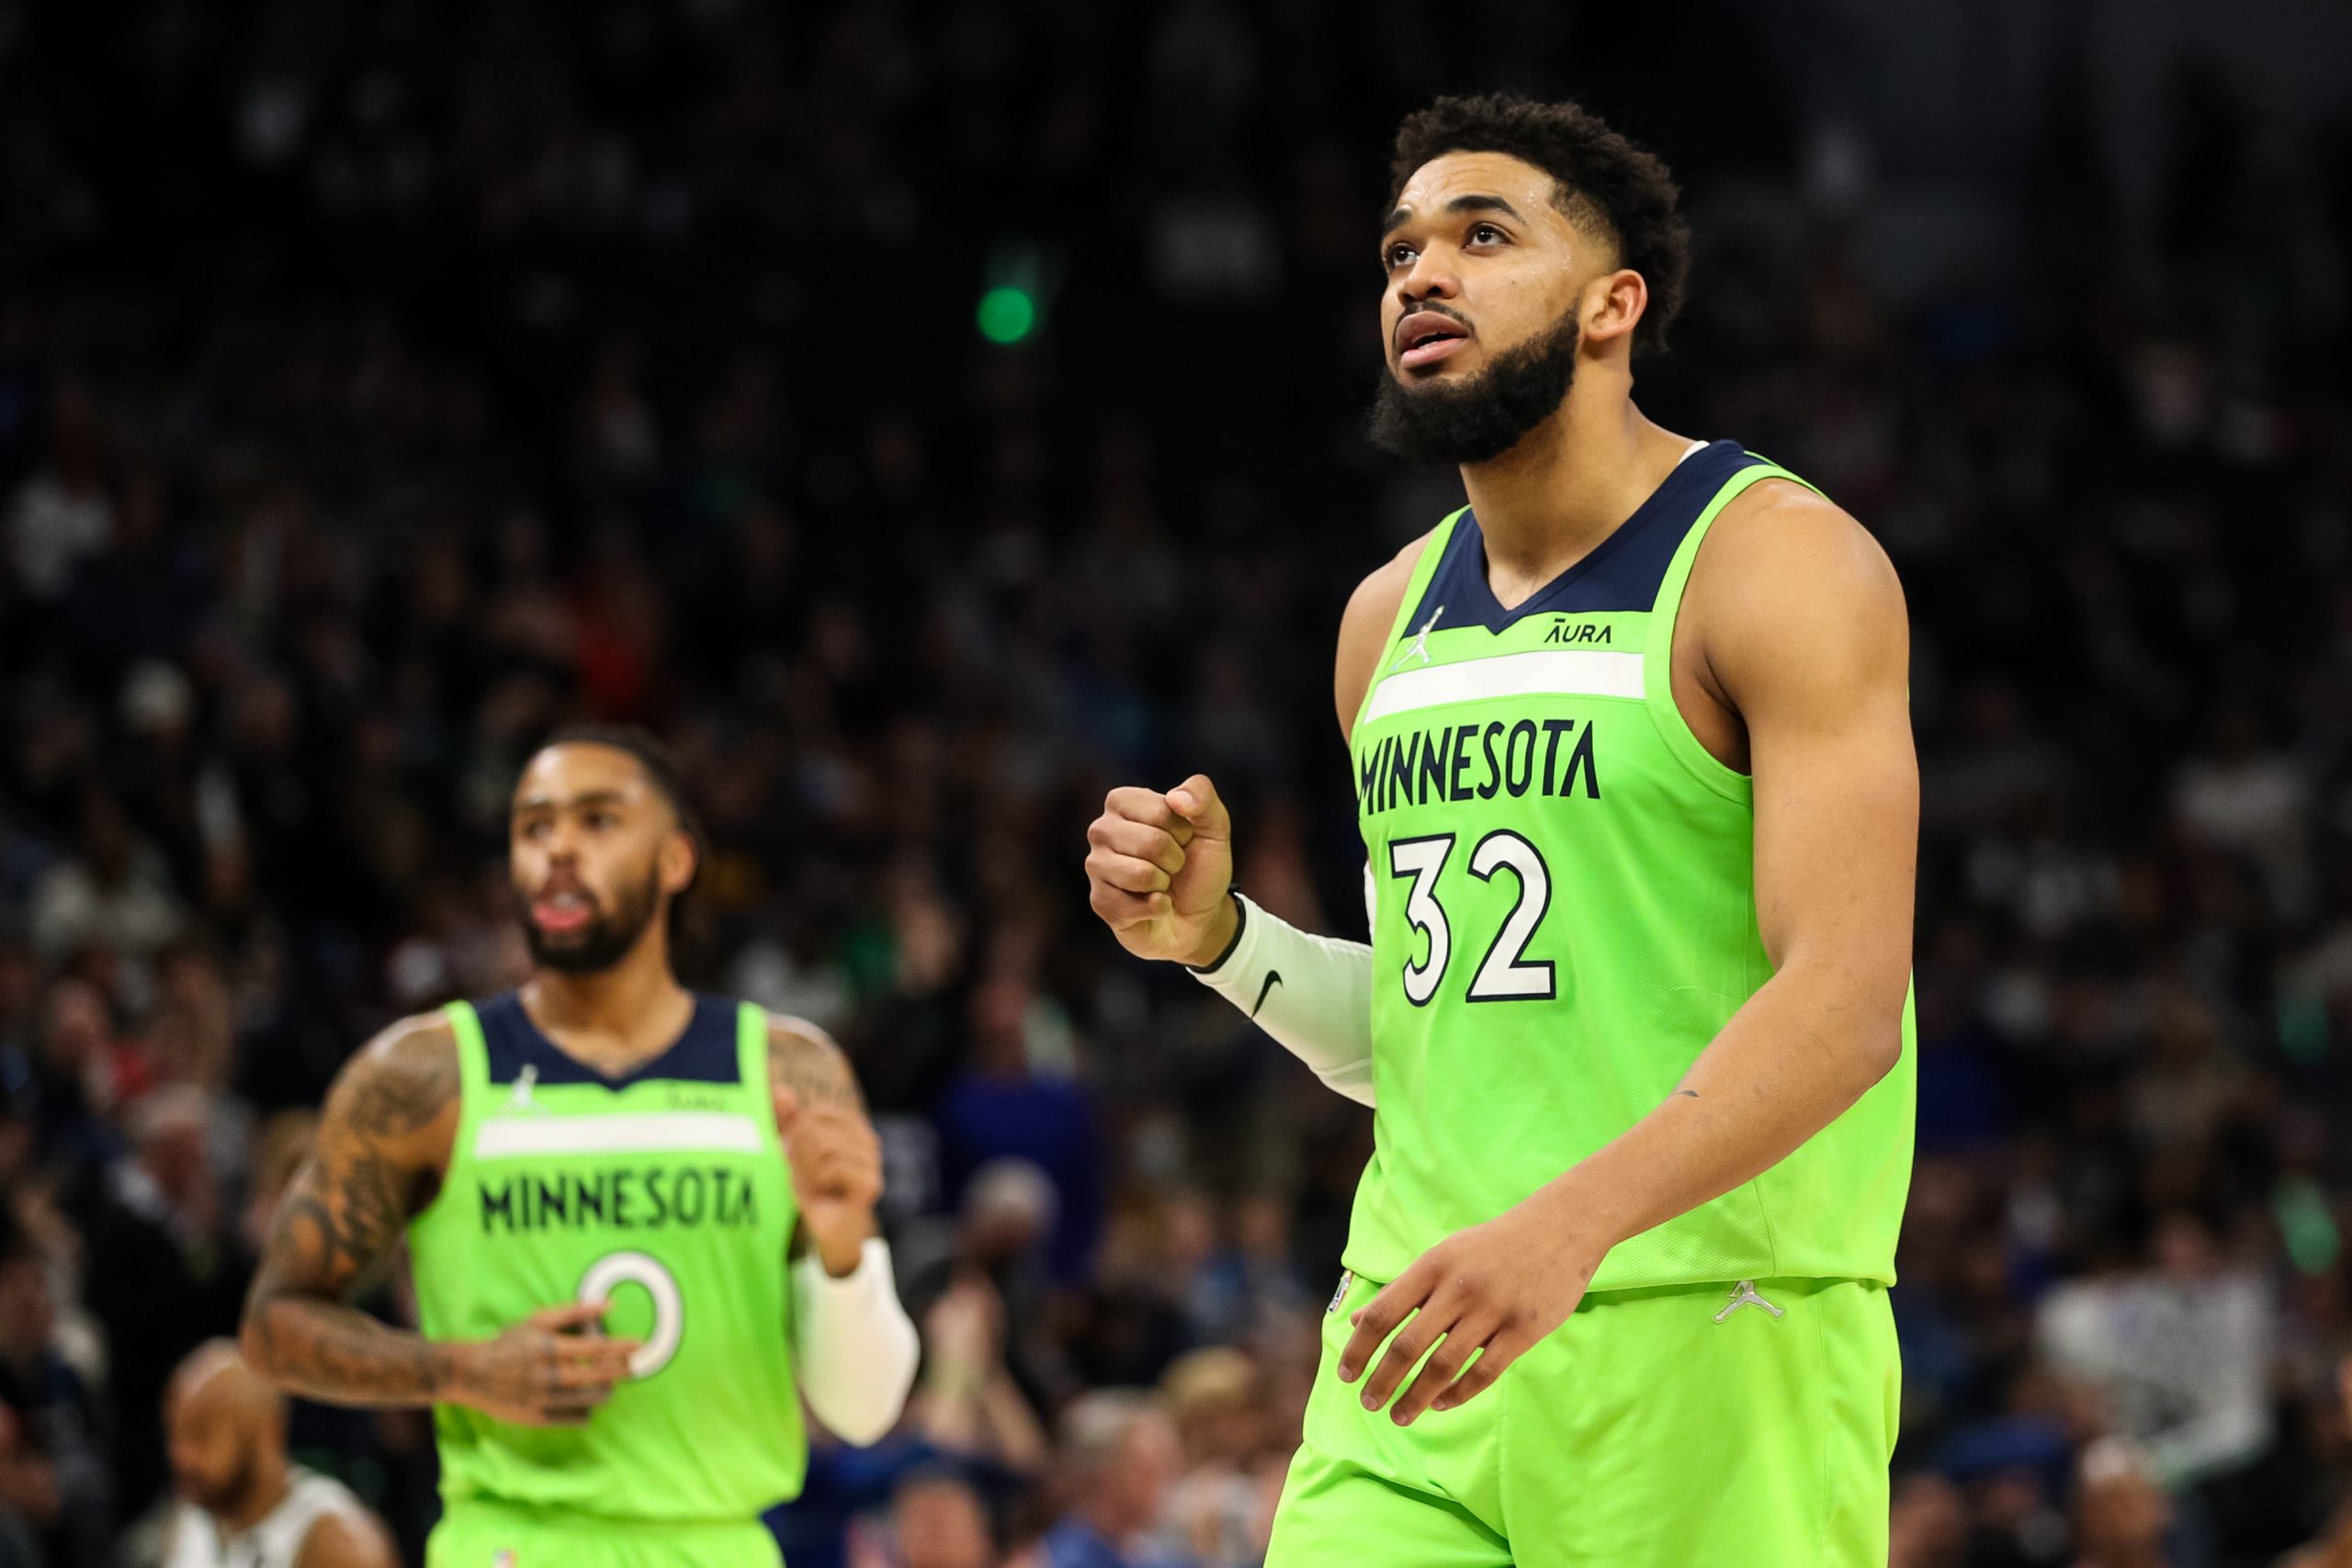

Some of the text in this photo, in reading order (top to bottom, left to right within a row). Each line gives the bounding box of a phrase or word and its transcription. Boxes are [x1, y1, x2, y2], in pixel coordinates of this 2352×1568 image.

[1361, 719, 1600, 816] MINNESOTA
[1389, 829, 1555, 1007] 32
[479, 1166, 758, 1235] MINNESOTA
